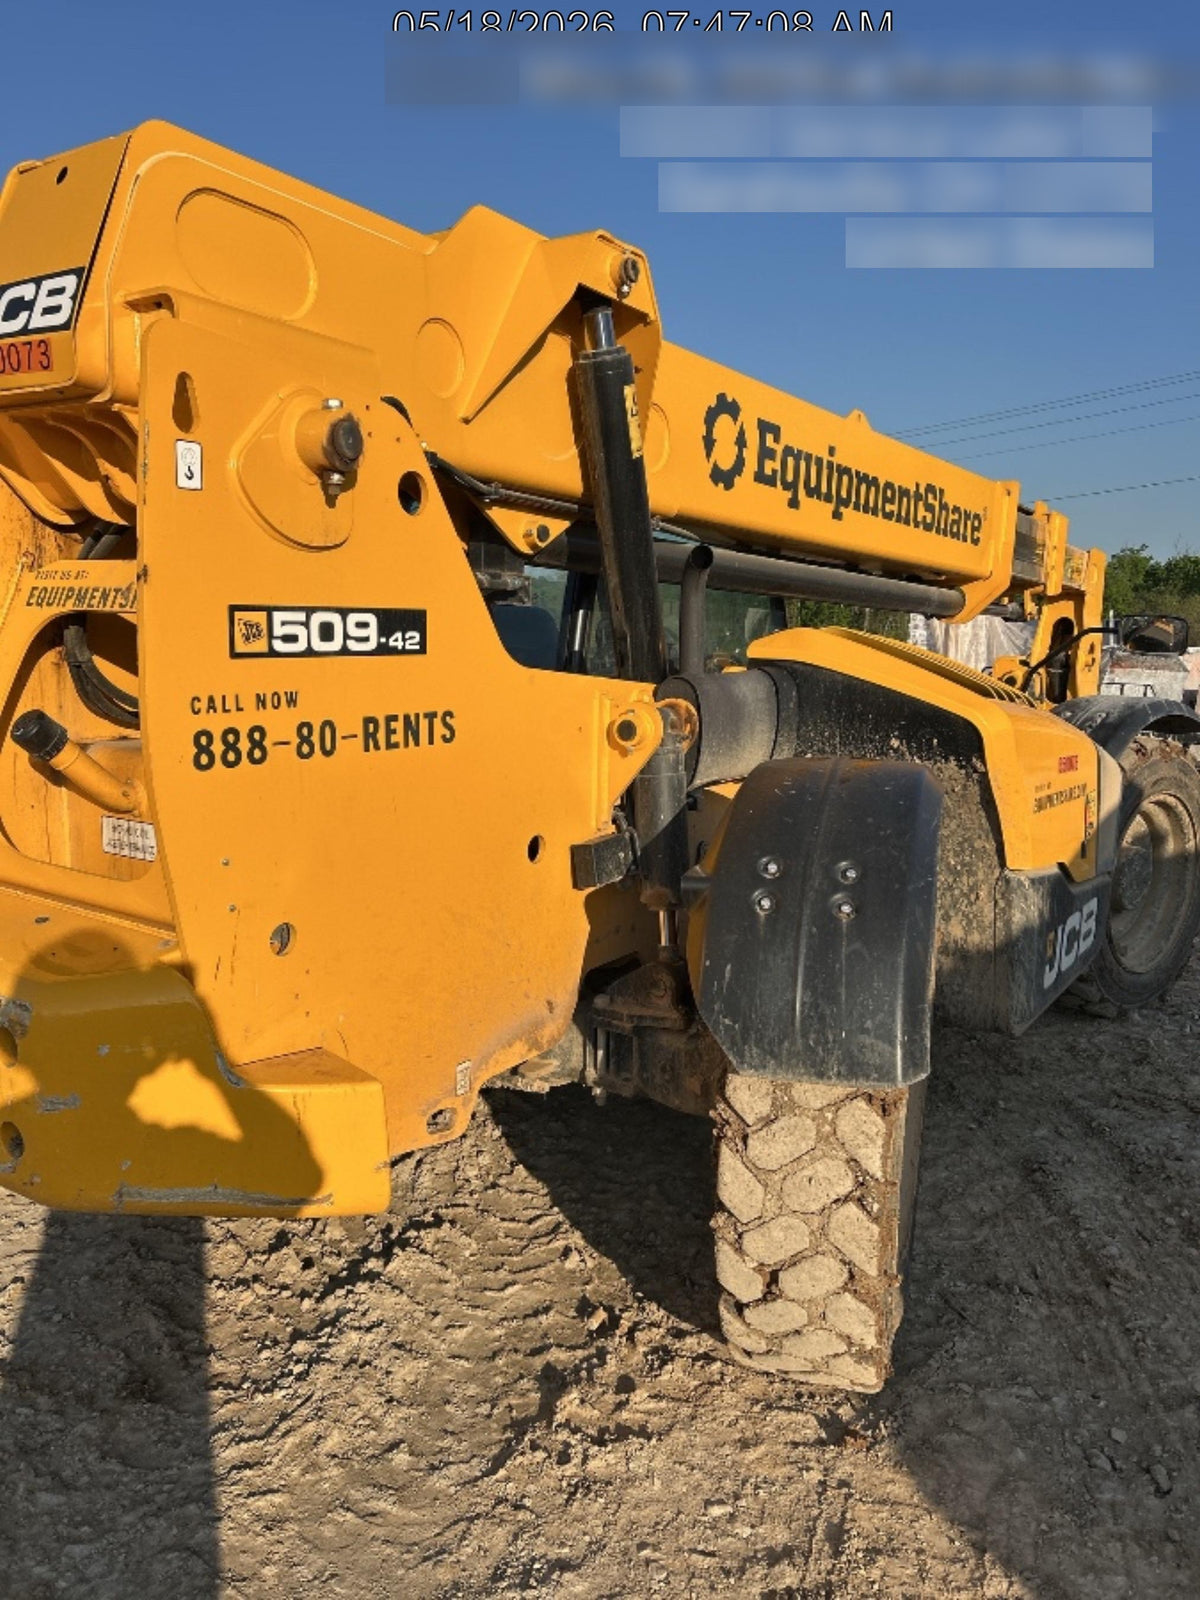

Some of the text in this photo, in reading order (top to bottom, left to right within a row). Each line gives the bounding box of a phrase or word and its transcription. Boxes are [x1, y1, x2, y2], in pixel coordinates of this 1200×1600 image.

[0, 275, 78, 335] CB
[754, 417, 983, 547] EquipmentShare
[190, 691, 299, 716] CALL NOW
[192, 710, 457, 772] 888-80-RENTS
[1043, 896, 1099, 990] JCB
